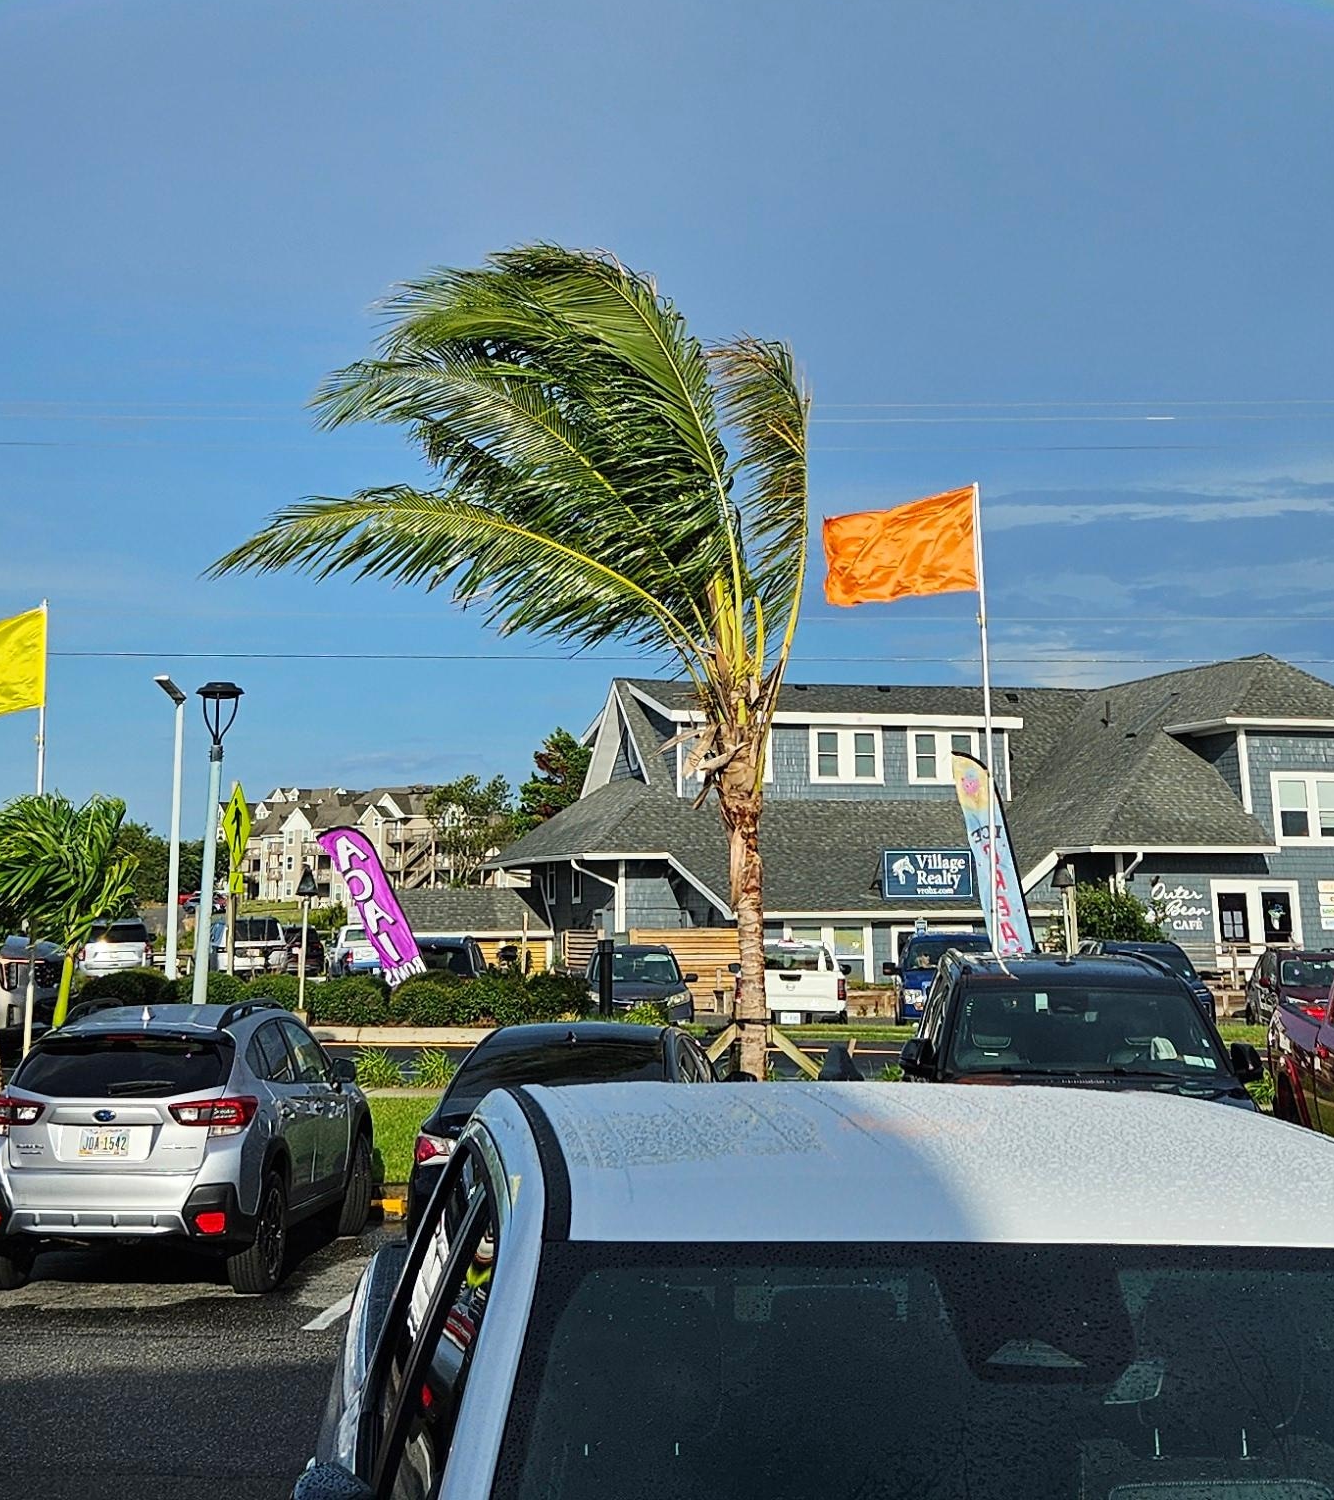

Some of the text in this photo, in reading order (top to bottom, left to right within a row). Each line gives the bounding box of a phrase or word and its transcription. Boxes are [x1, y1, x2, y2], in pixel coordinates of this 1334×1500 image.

[915, 853, 966, 873] Village
[916, 869, 961, 890] Realty
[1151, 882, 1203, 901] Outer
[1165, 898, 1211, 917] Bean
[1172, 917, 1204, 931] CAFÉ
